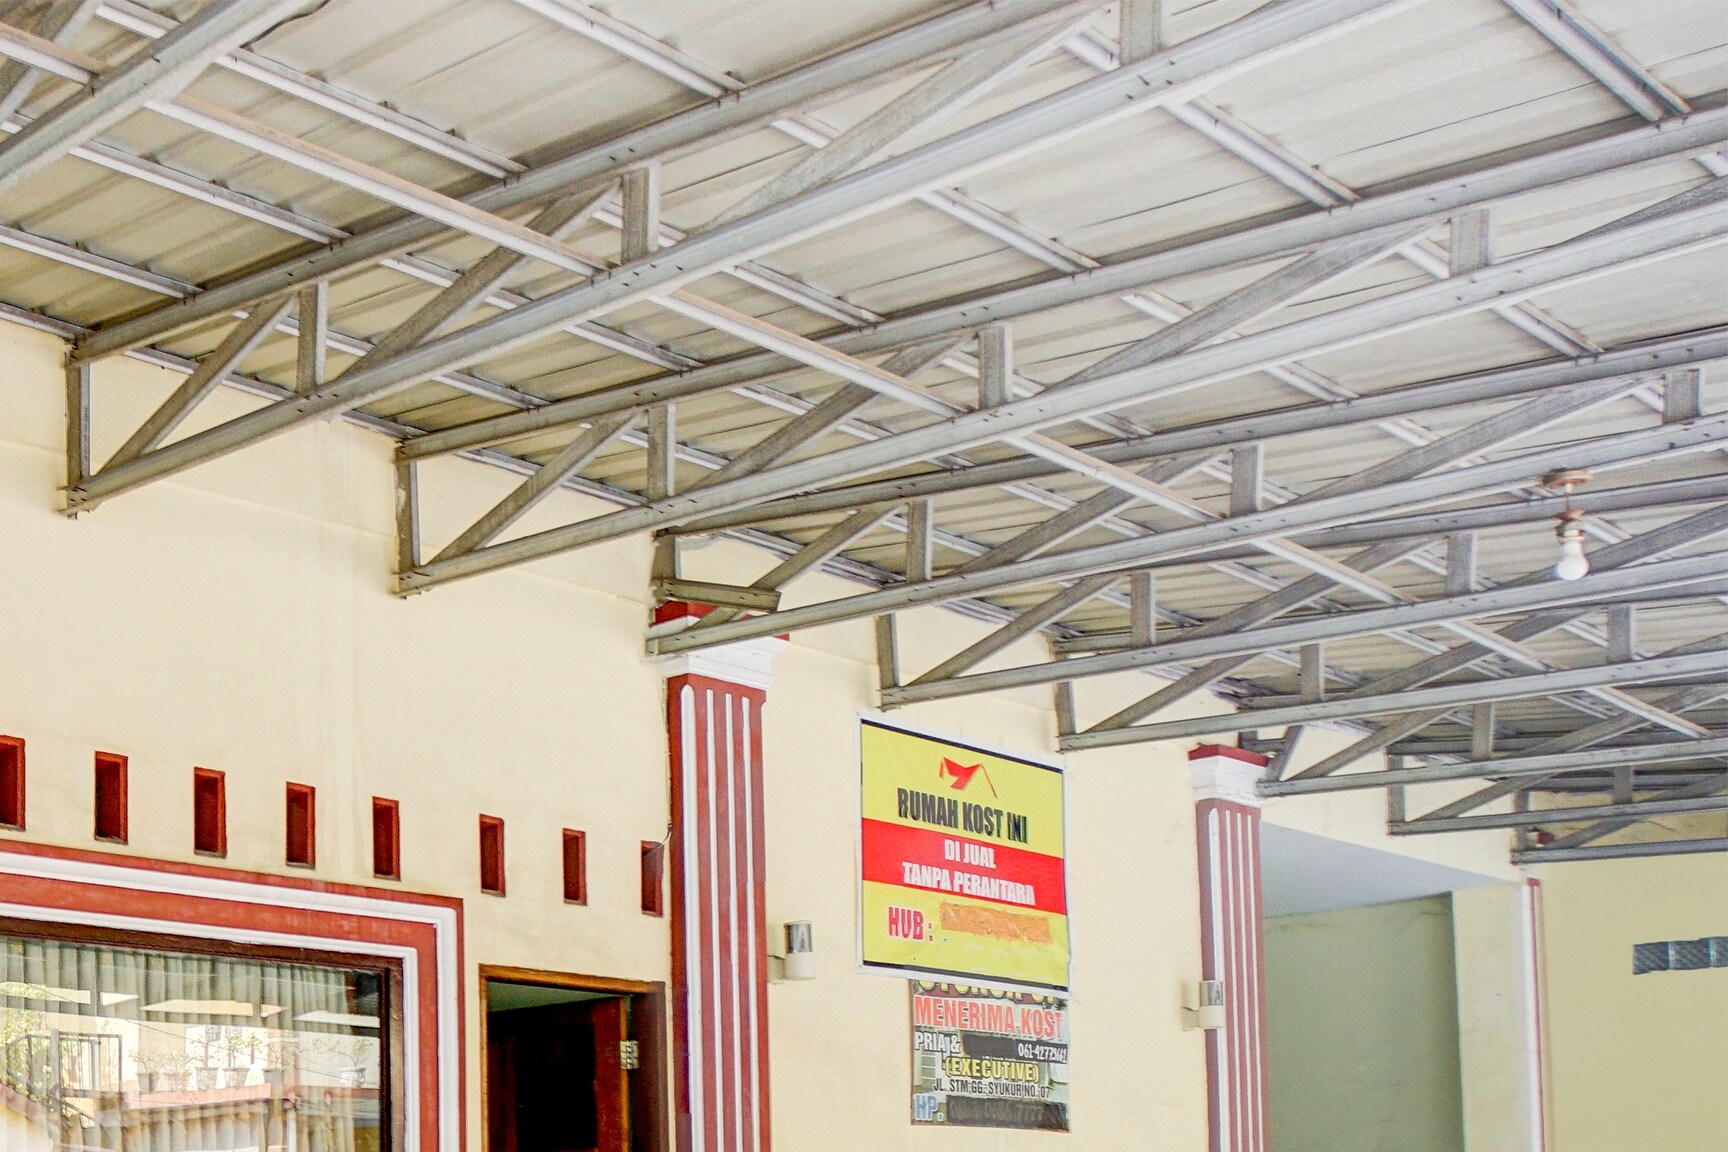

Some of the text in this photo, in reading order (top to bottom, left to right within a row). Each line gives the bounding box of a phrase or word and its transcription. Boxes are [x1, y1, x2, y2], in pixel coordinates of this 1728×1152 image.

[897, 787, 1028, 843] RUMAH KOST INI
[944, 838, 997, 869] DI JUAL
[902, 861, 1036, 906] TANPA PERANTARA
[914, 995, 1063, 1040] MENERIMA KOST
[914, 1031, 961, 1053] PRIA &
[944, 1056, 1040, 1083] (EXECUTIVE)
[933, 1078, 947, 1091] JL.
[949, 1079, 969, 1093] STM
[988, 1081, 1022, 1096] SYUKUR
